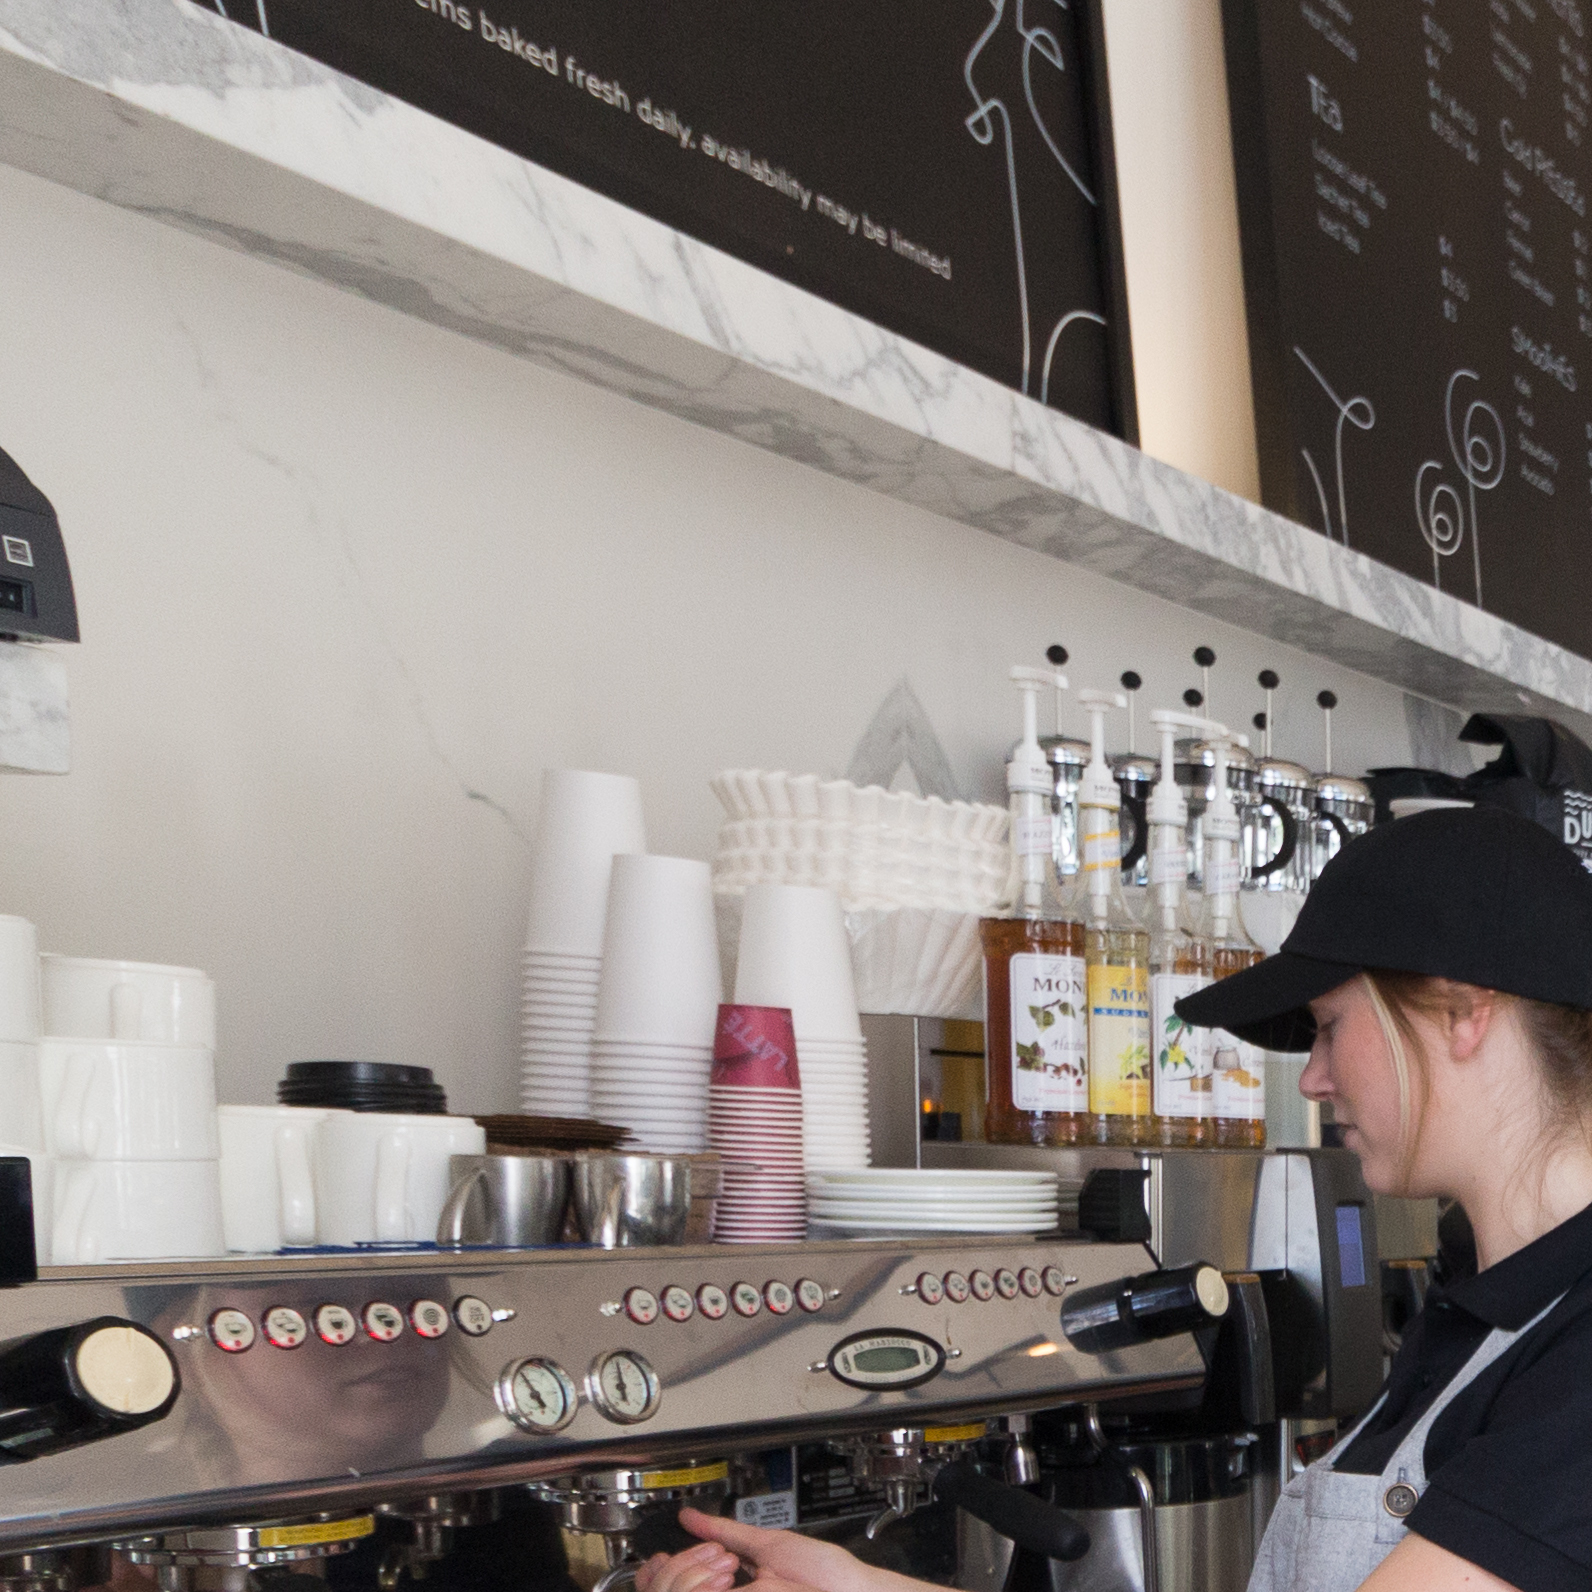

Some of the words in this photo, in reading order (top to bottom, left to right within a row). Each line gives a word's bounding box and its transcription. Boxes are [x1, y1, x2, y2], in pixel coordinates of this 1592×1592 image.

[479, 8, 560, 76] baked
[565, 55, 631, 113] fresh
[701, 133, 812, 211] availability
[816, 194, 859, 236] may
[861, 213, 888, 248] be
[890, 227, 952, 281] limited
